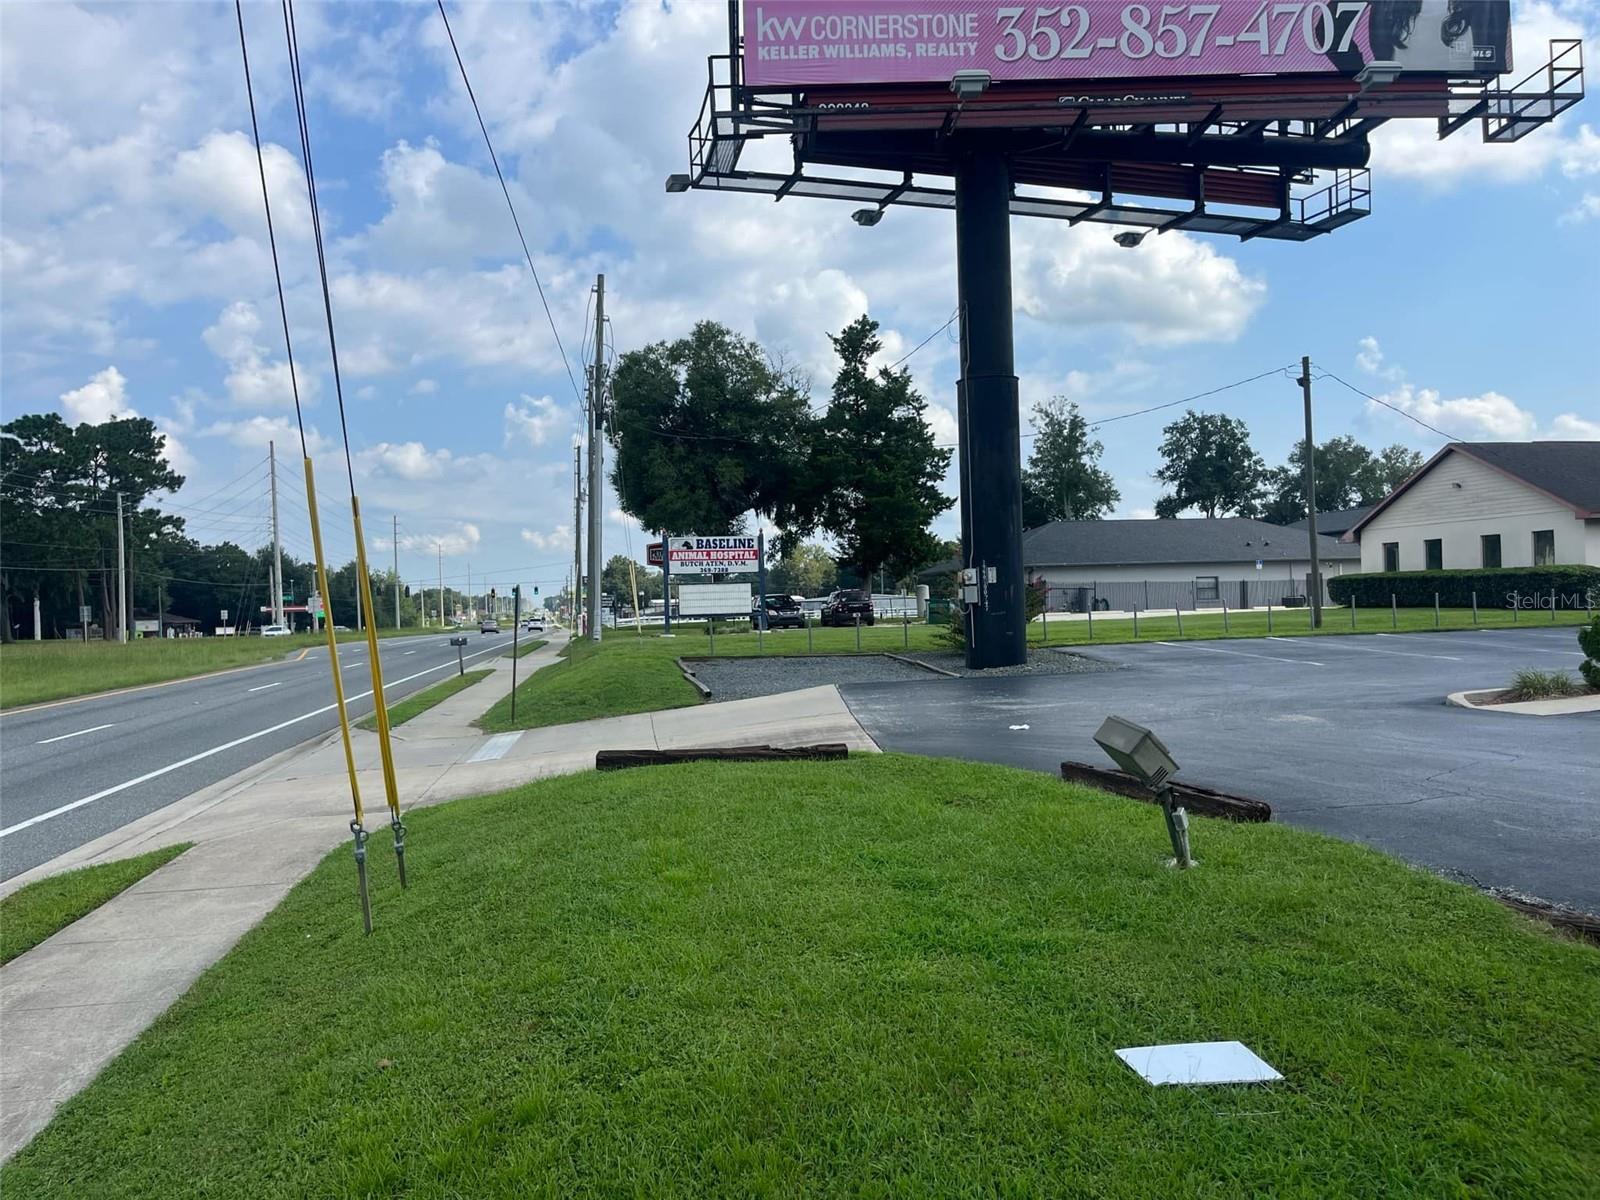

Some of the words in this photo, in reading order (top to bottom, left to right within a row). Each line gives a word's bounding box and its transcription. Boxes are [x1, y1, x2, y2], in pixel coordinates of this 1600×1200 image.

[757, 8, 806, 41] kw
[810, 13, 979, 40] CORNERSTONE
[993, 2, 1368, 62] 352-857-4707
[758, 45, 819, 60] KELLER
[823, 42, 912, 59] WILLIAMS,
[915, 41, 978, 57] REALTY
[696, 538, 754, 549] BASELINE
[672, 551, 709, 560] ANIMAL
[710, 550, 756, 560] HOSPITAL
